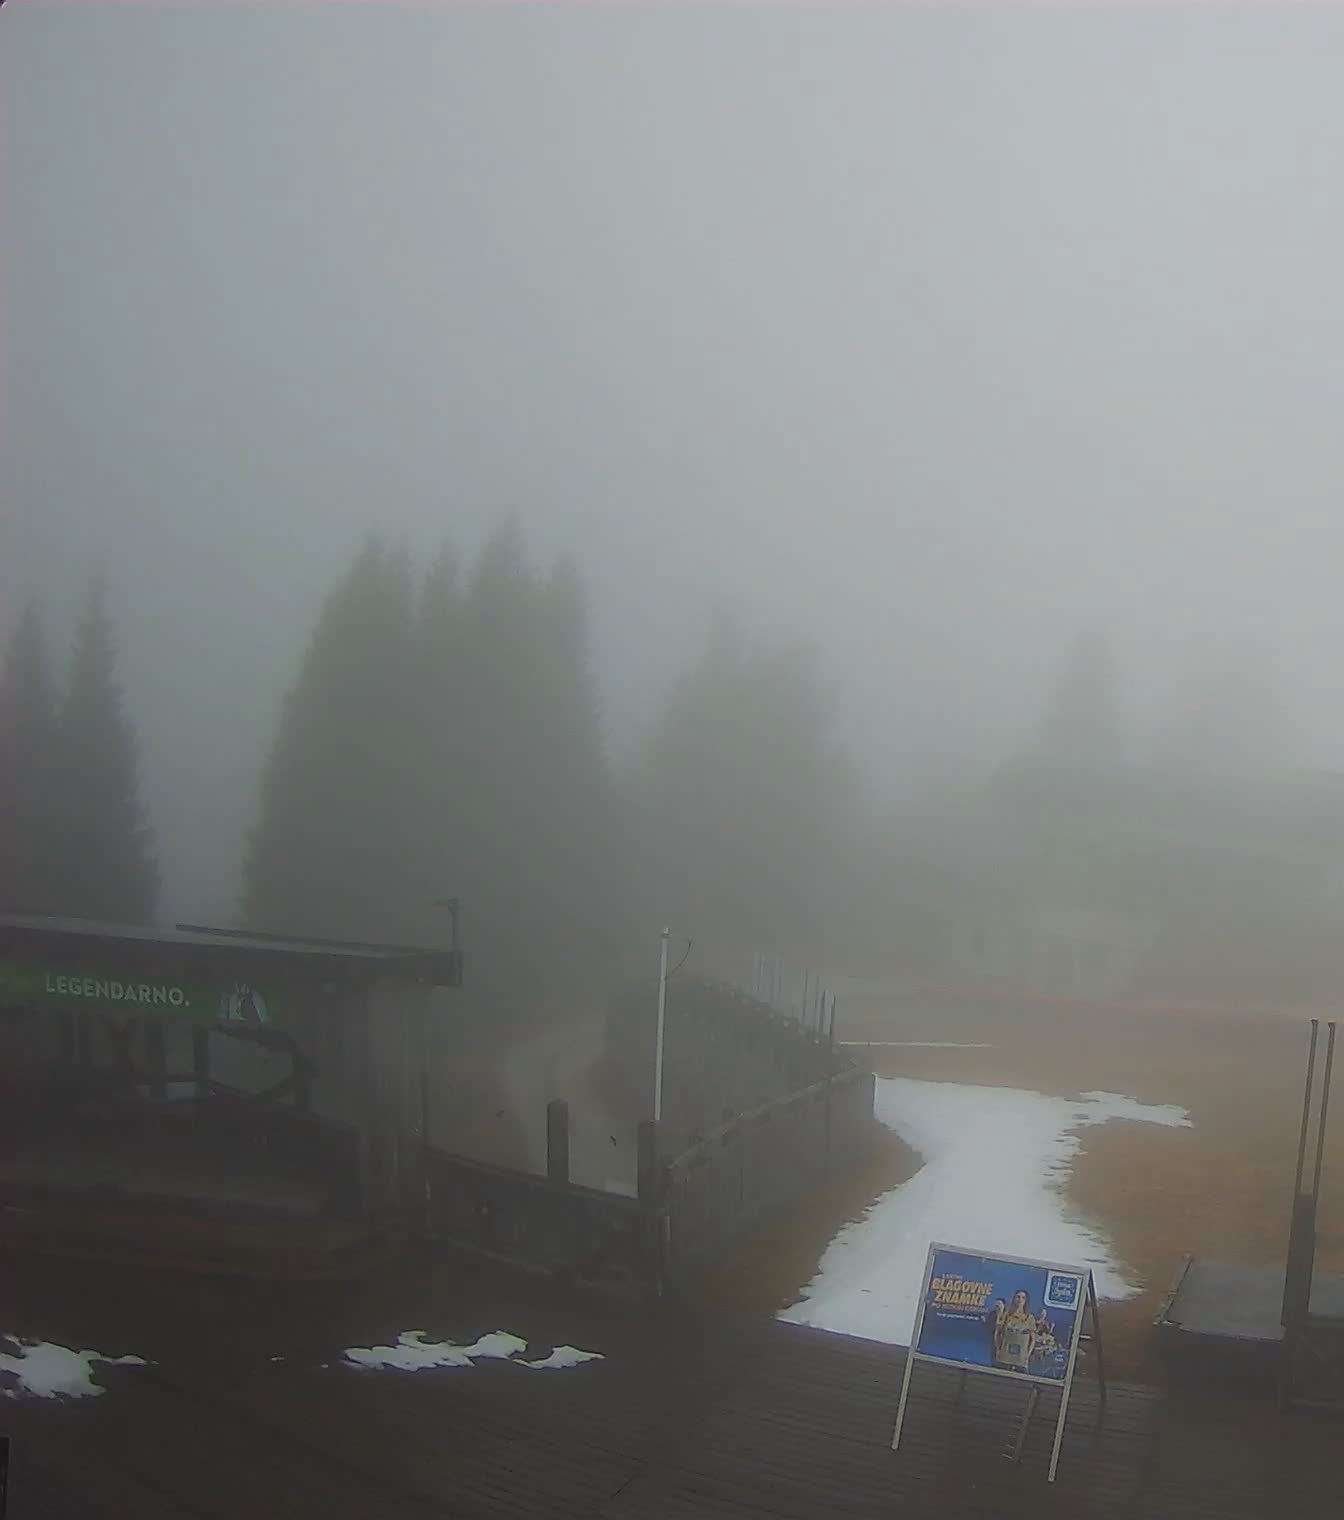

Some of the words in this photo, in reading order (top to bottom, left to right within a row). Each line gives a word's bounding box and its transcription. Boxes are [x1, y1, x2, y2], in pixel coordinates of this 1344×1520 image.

[45, 974, 190, 1006] LEGENDARNO.
[931, 1278, 993, 1295] BLAGOVNE
[934, 1290, 987, 1306] ZNAMKE
